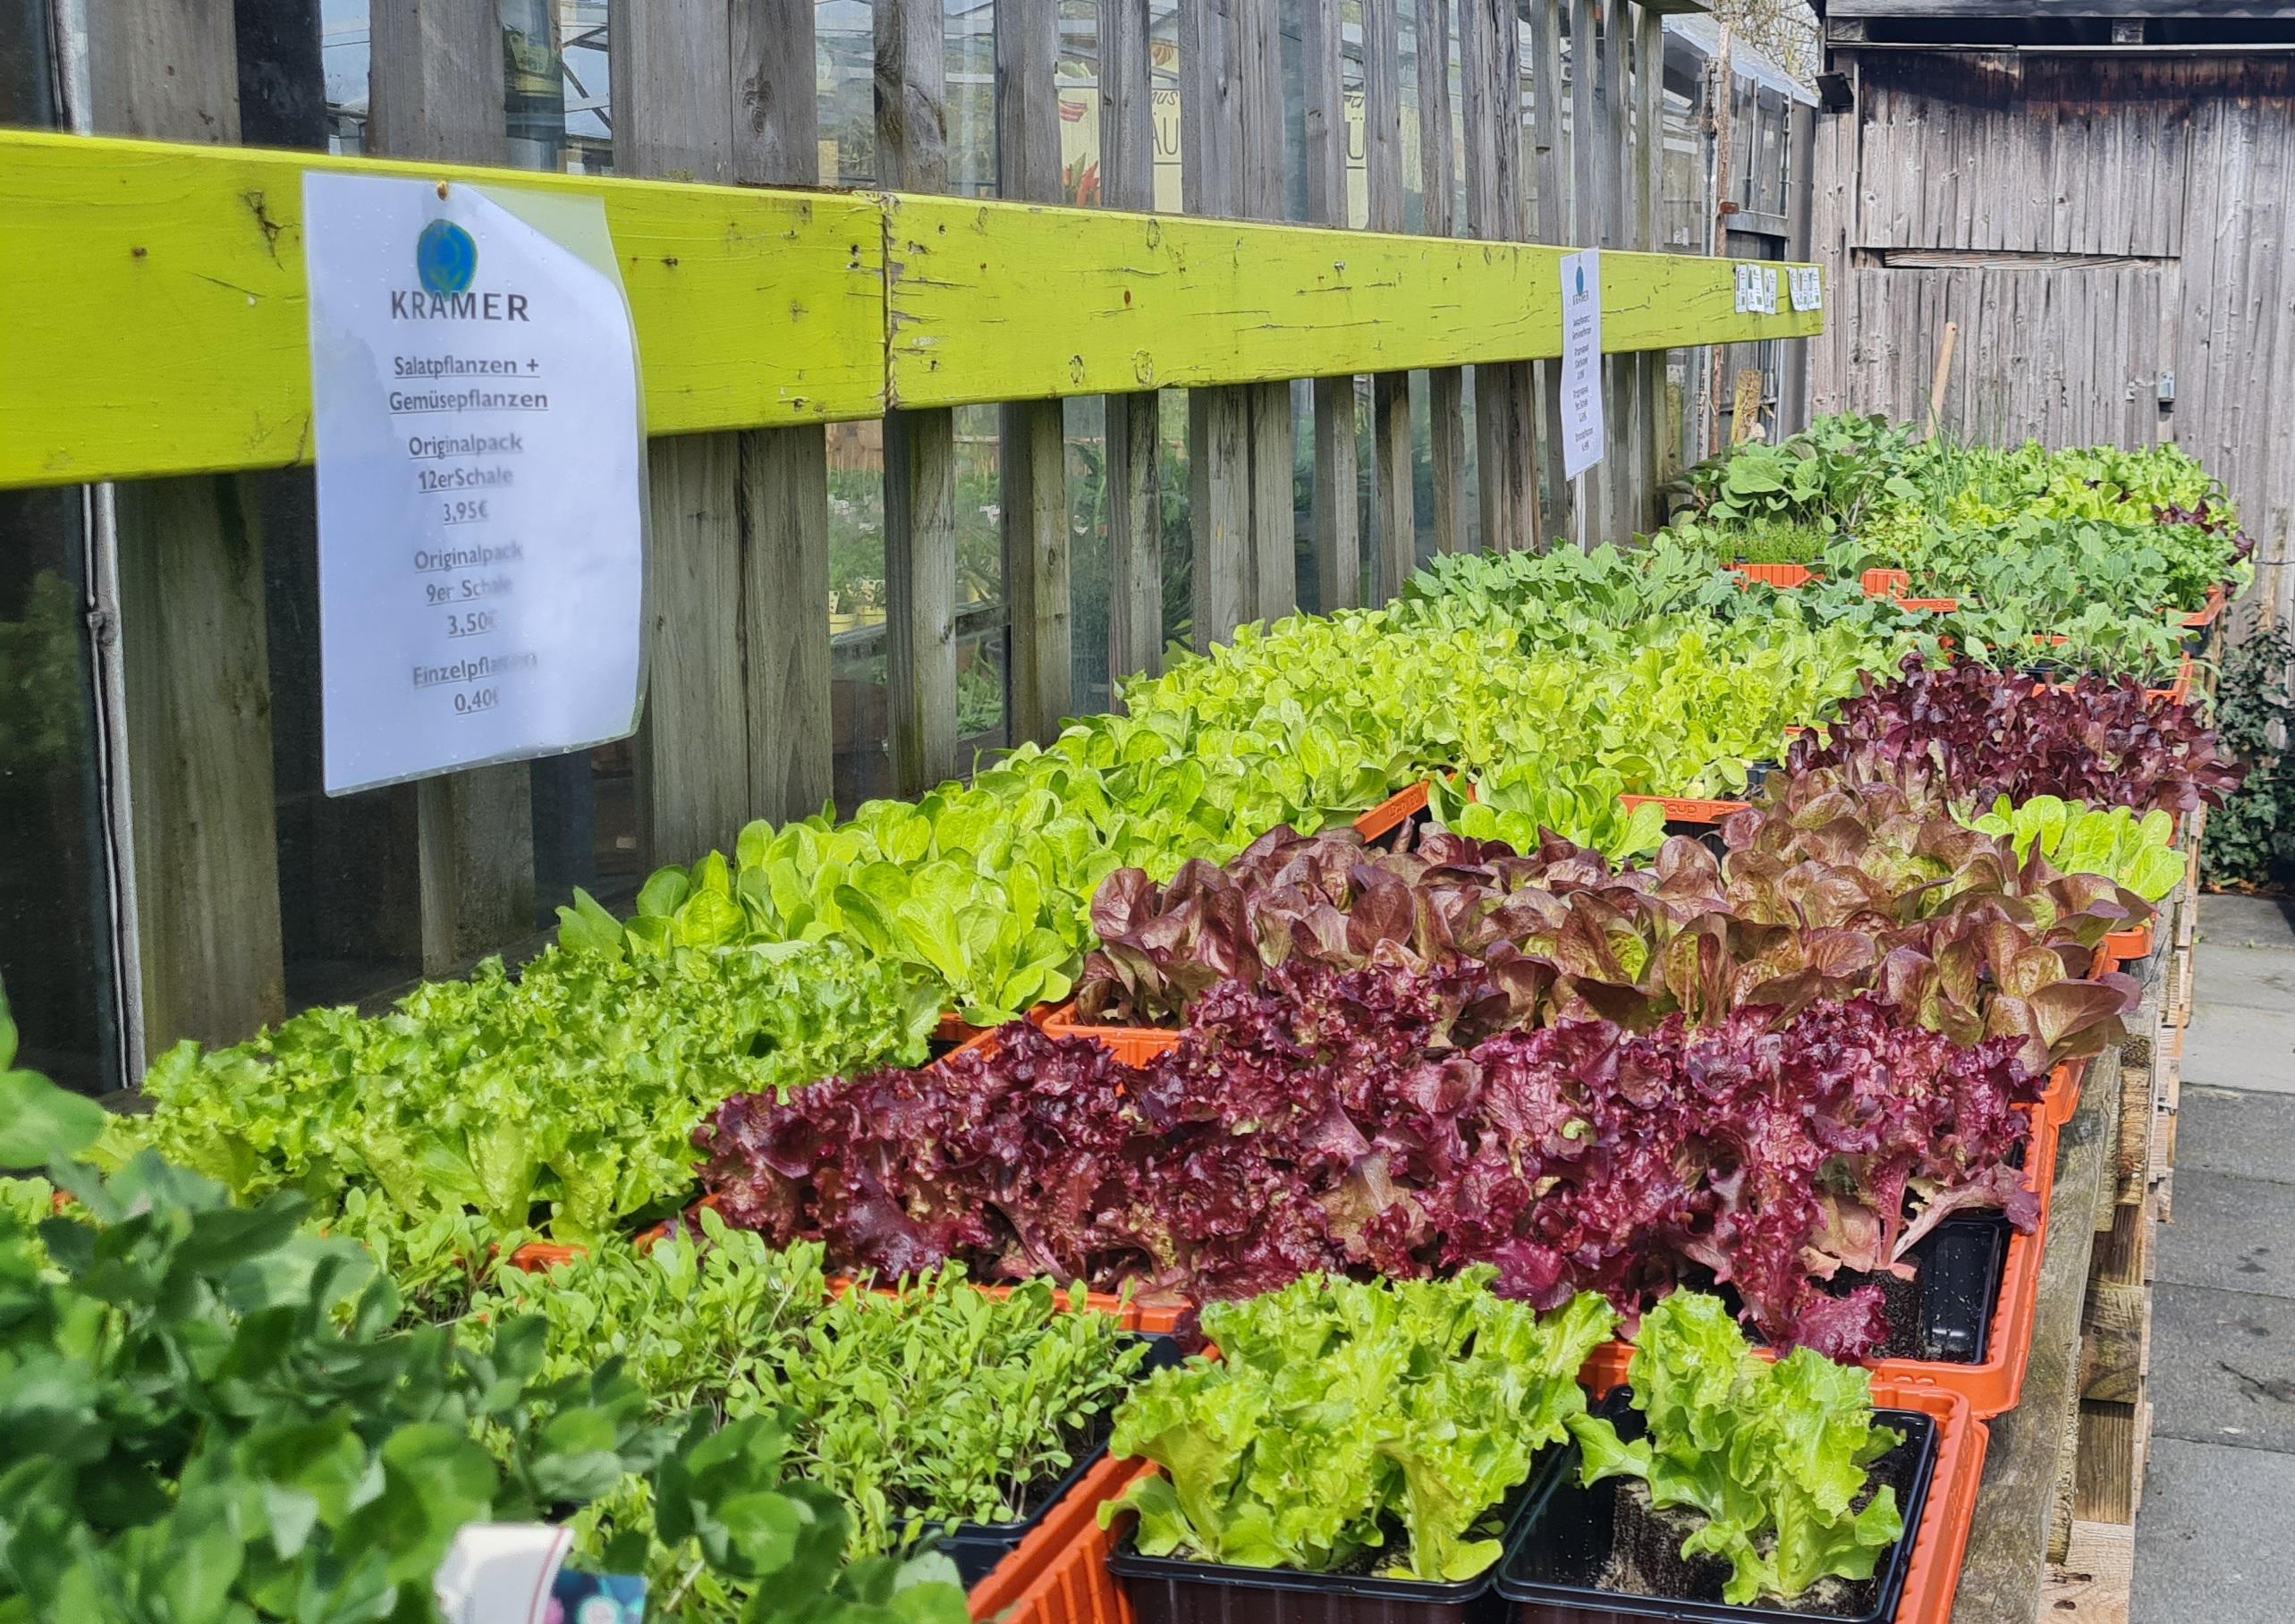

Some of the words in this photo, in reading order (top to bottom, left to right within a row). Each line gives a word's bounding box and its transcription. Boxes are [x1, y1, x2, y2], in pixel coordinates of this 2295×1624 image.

[391, 291, 530, 322] KRAMER
[394, 356, 517, 378] Salatpflanzen
[390, 389, 547, 413] Gemüsepflanzen
[409, 432, 523, 459] Originalpack
[444, 500, 488, 522] 3,95€
[427, 583, 453, 603] 9er
[448, 609, 497, 636] 3,50
